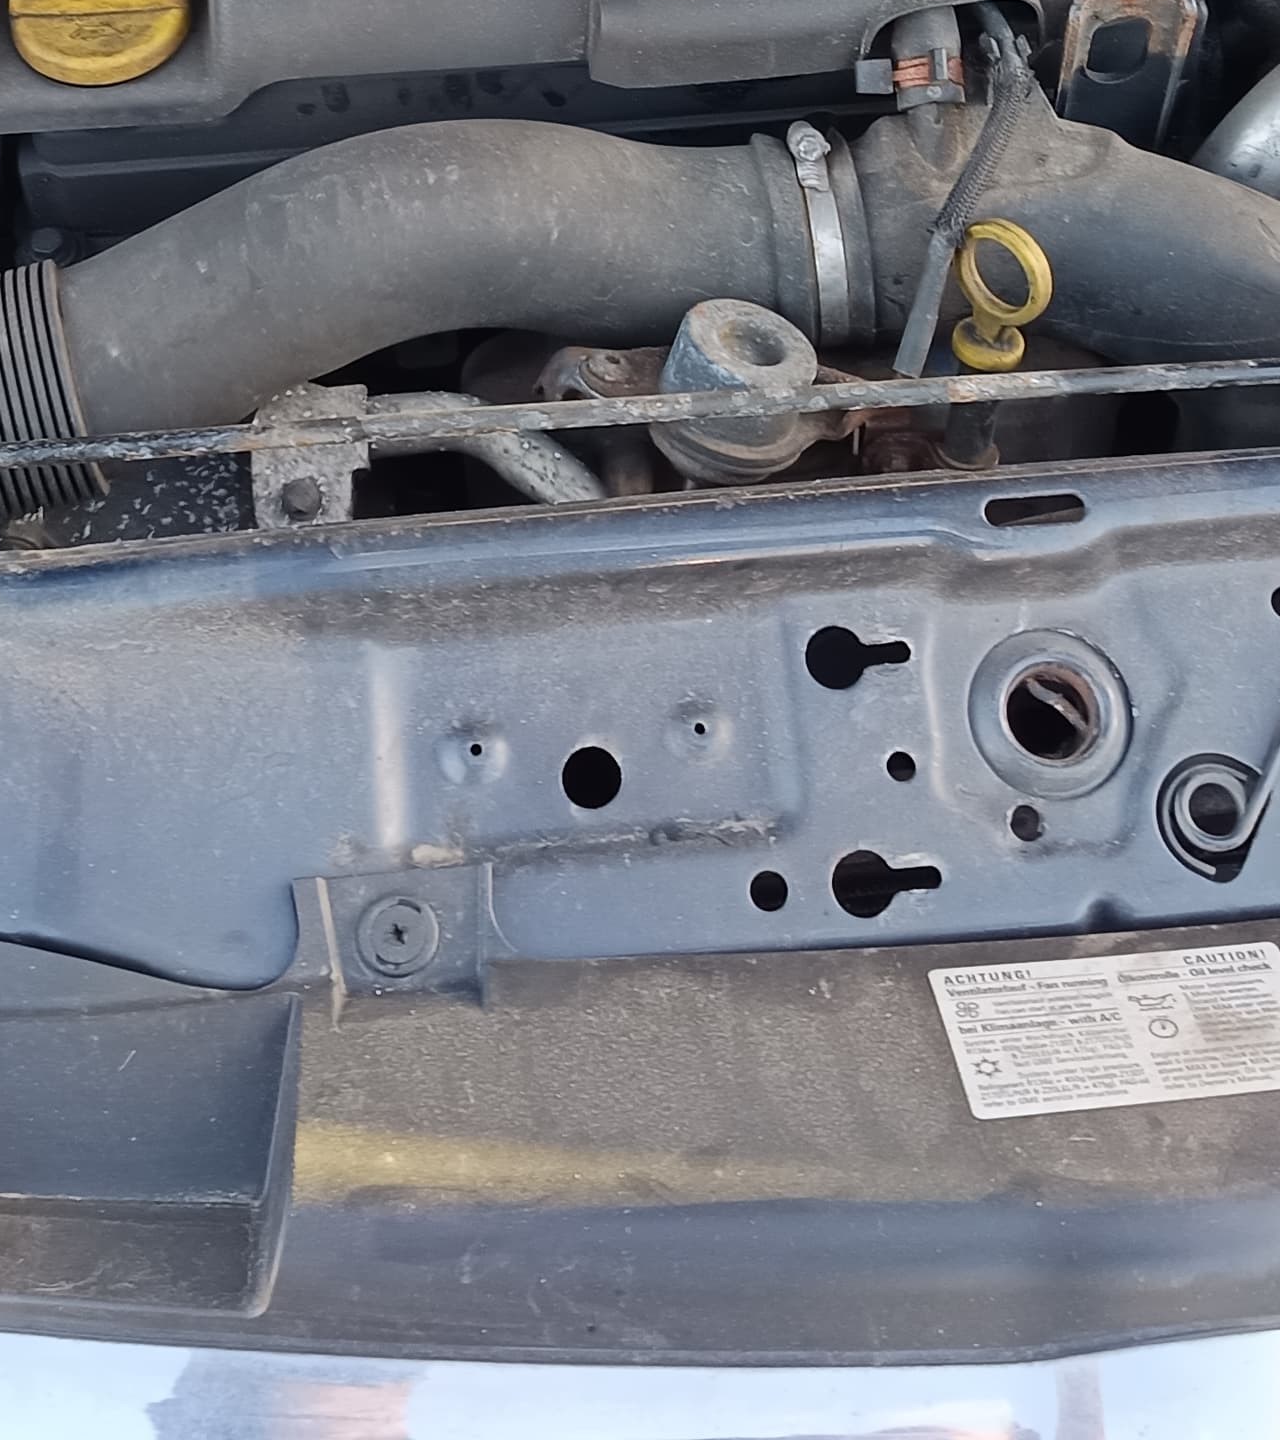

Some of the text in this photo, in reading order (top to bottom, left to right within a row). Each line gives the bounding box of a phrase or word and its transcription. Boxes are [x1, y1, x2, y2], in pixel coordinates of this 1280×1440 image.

[1182, 949, 1267, 965] CAUTION!
[943, 969, 1032, 985] ACHTUNG!
[1188, 966, 1207, 977] Oil
[1208, 964, 1235, 976] level
[1237, 961, 1273, 972] check
[1036, 981, 1059, 991] Fan
[1060, 977, 1109, 989] running
[1067, 1014, 1098, 1026] with
[1098, 1010, 1123, 1024] A/C
